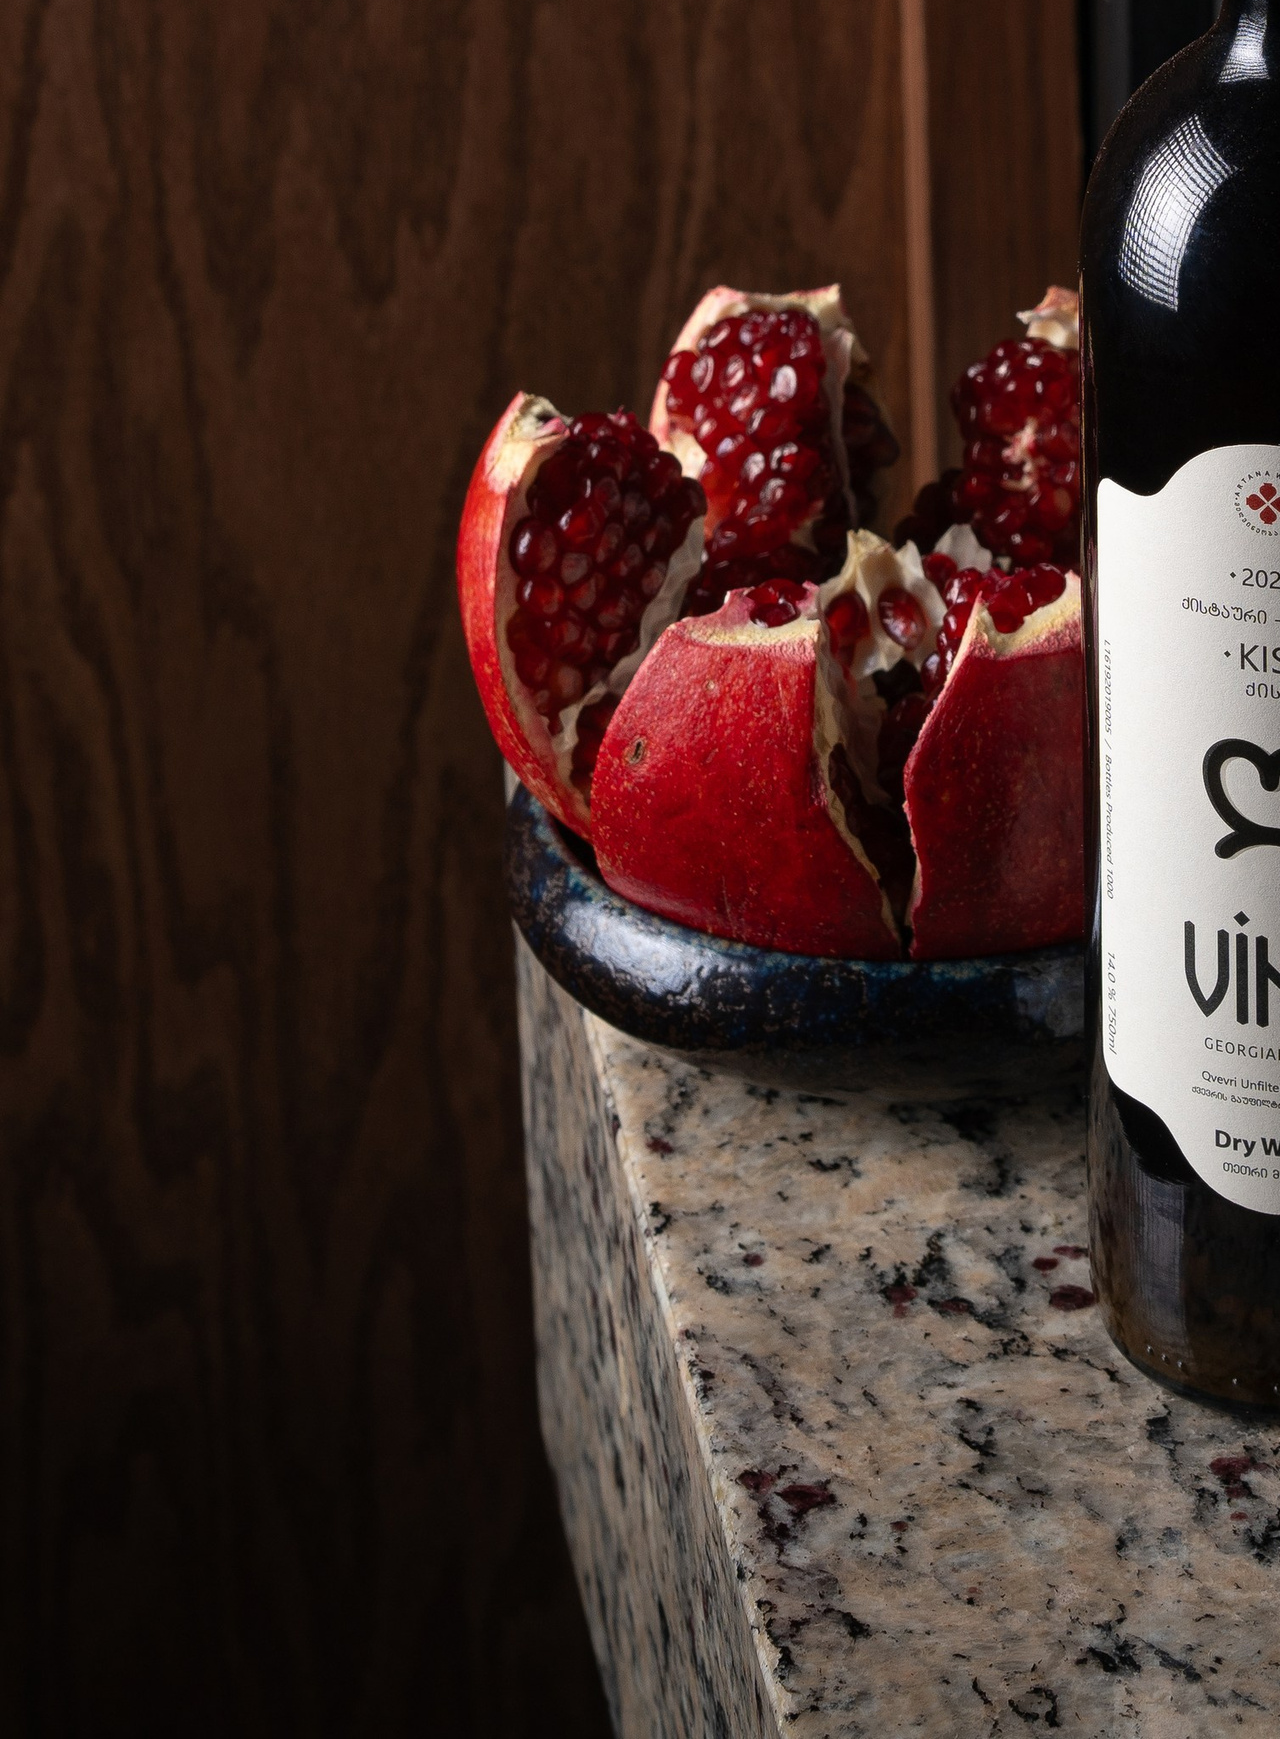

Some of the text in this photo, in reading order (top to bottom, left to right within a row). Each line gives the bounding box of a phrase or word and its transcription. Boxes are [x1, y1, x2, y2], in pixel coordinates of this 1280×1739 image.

[1234, 470, 1271, 497] ARTANA
[1182, 597, 1267, 625] ქისტაური
[1105, 754, 1113, 799] Bottles
[1105, 802, 1114, 864] Produced
[1106, 869, 1114, 900] 1000
[1107, 952, 1118, 1055] 14.0 % 750ml
[1201, 1070, 1237, 1088] Qvevri
[1215, 1129, 1257, 1157] Dry
[1223, 1162, 1268, 1179] თეთრი
